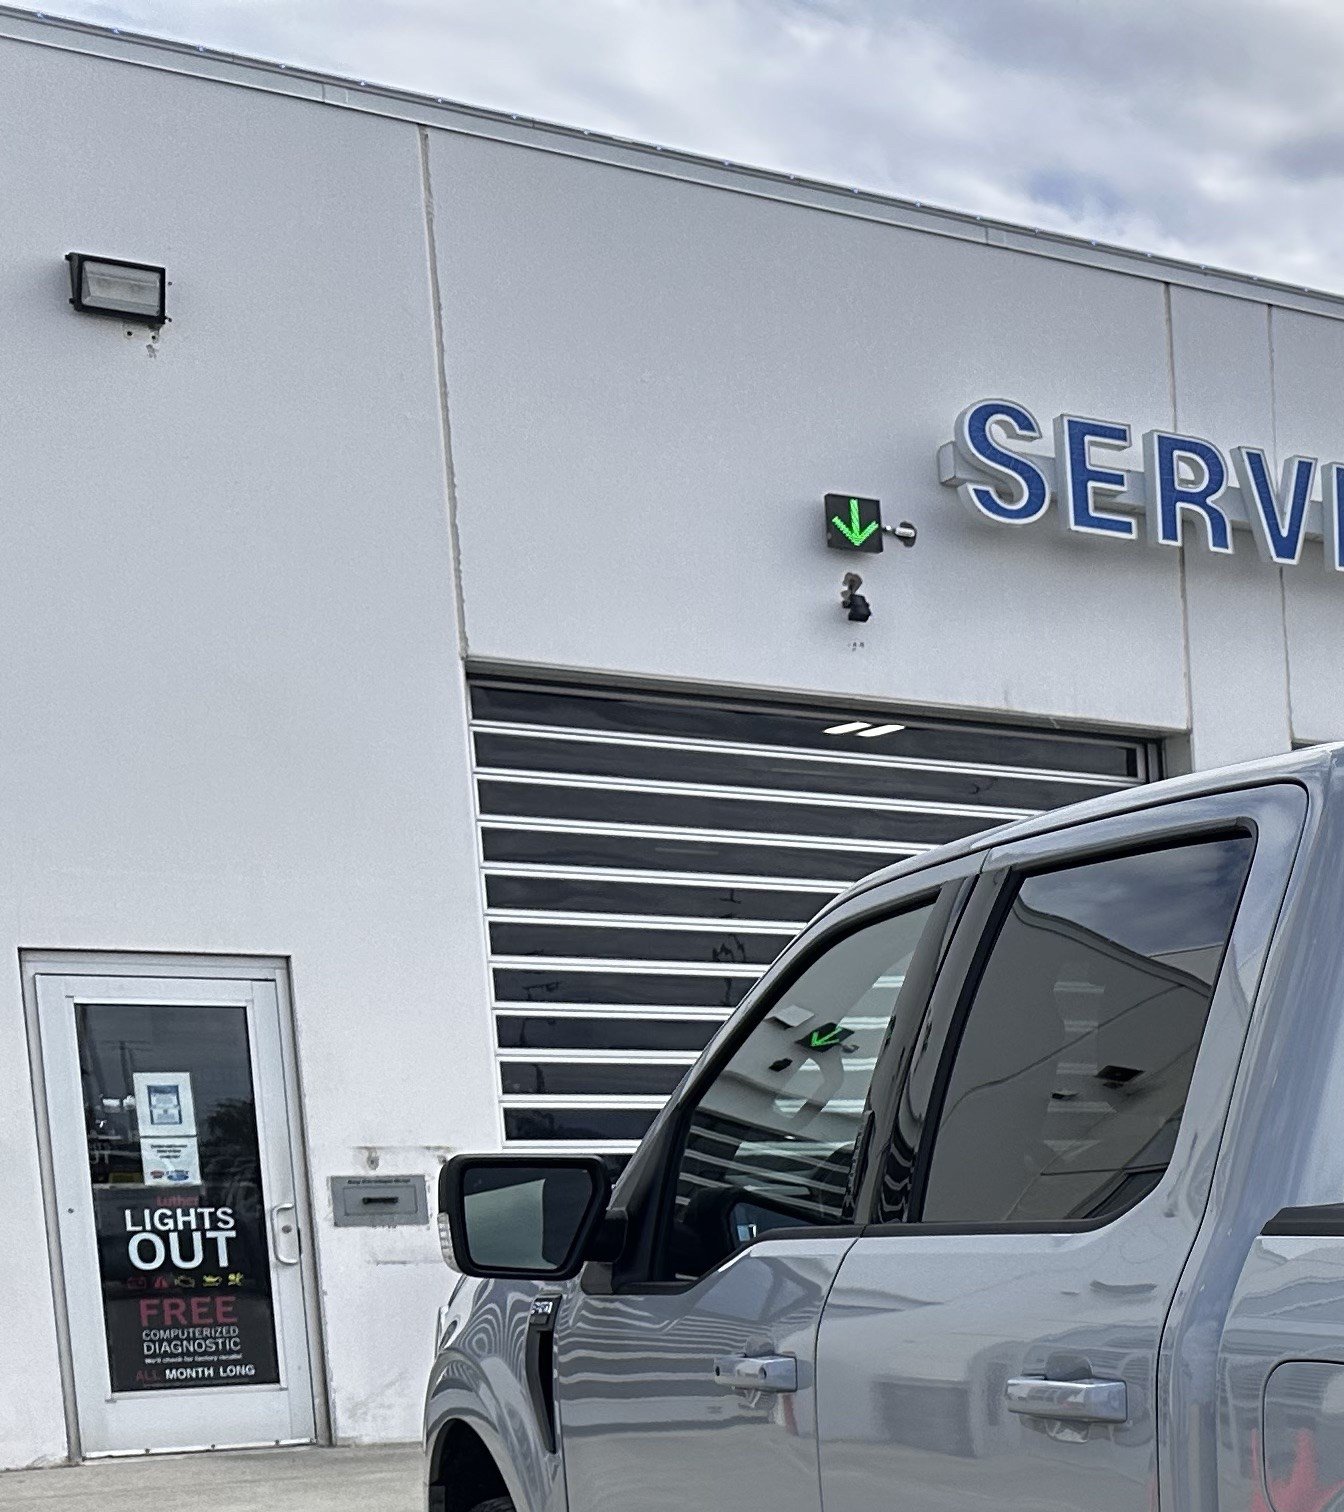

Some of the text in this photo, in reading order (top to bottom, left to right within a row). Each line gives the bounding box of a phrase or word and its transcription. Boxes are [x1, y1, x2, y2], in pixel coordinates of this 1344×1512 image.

[124, 1206, 236, 1232] LIGHTS
[127, 1230, 237, 1271] OUT
[138, 1295, 239, 1328] FREE
[142, 1325, 240, 1341] COMPUTERIZED
[143, 1337, 242, 1355] DIAGNOSTIC
[165, 1366, 215, 1380] MONTH
[219, 1363, 256, 1378] LONG
